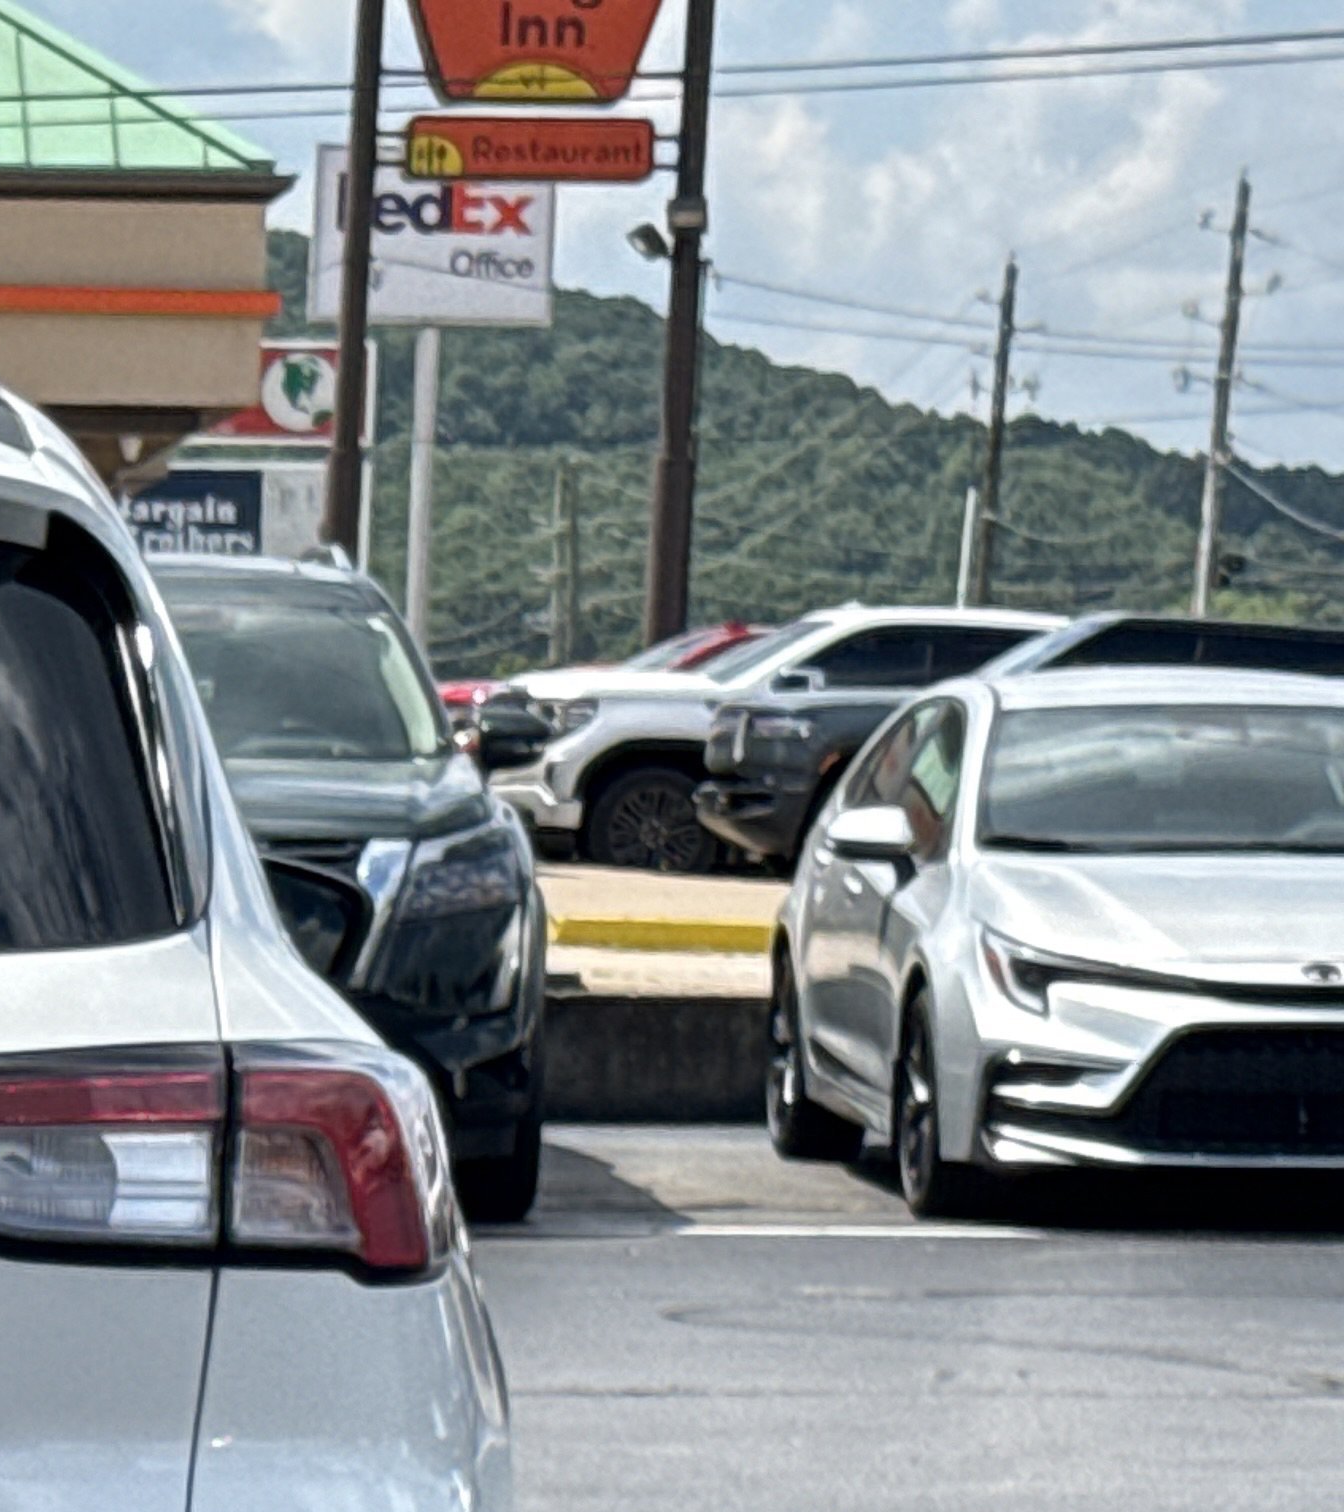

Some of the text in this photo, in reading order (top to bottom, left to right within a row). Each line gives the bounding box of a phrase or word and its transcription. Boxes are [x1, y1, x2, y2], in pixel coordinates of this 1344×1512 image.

[502, 2, 586, 46] Inn
[472, 134, 642, 166] Restaurant
[449, 249, 536, 278] Office
